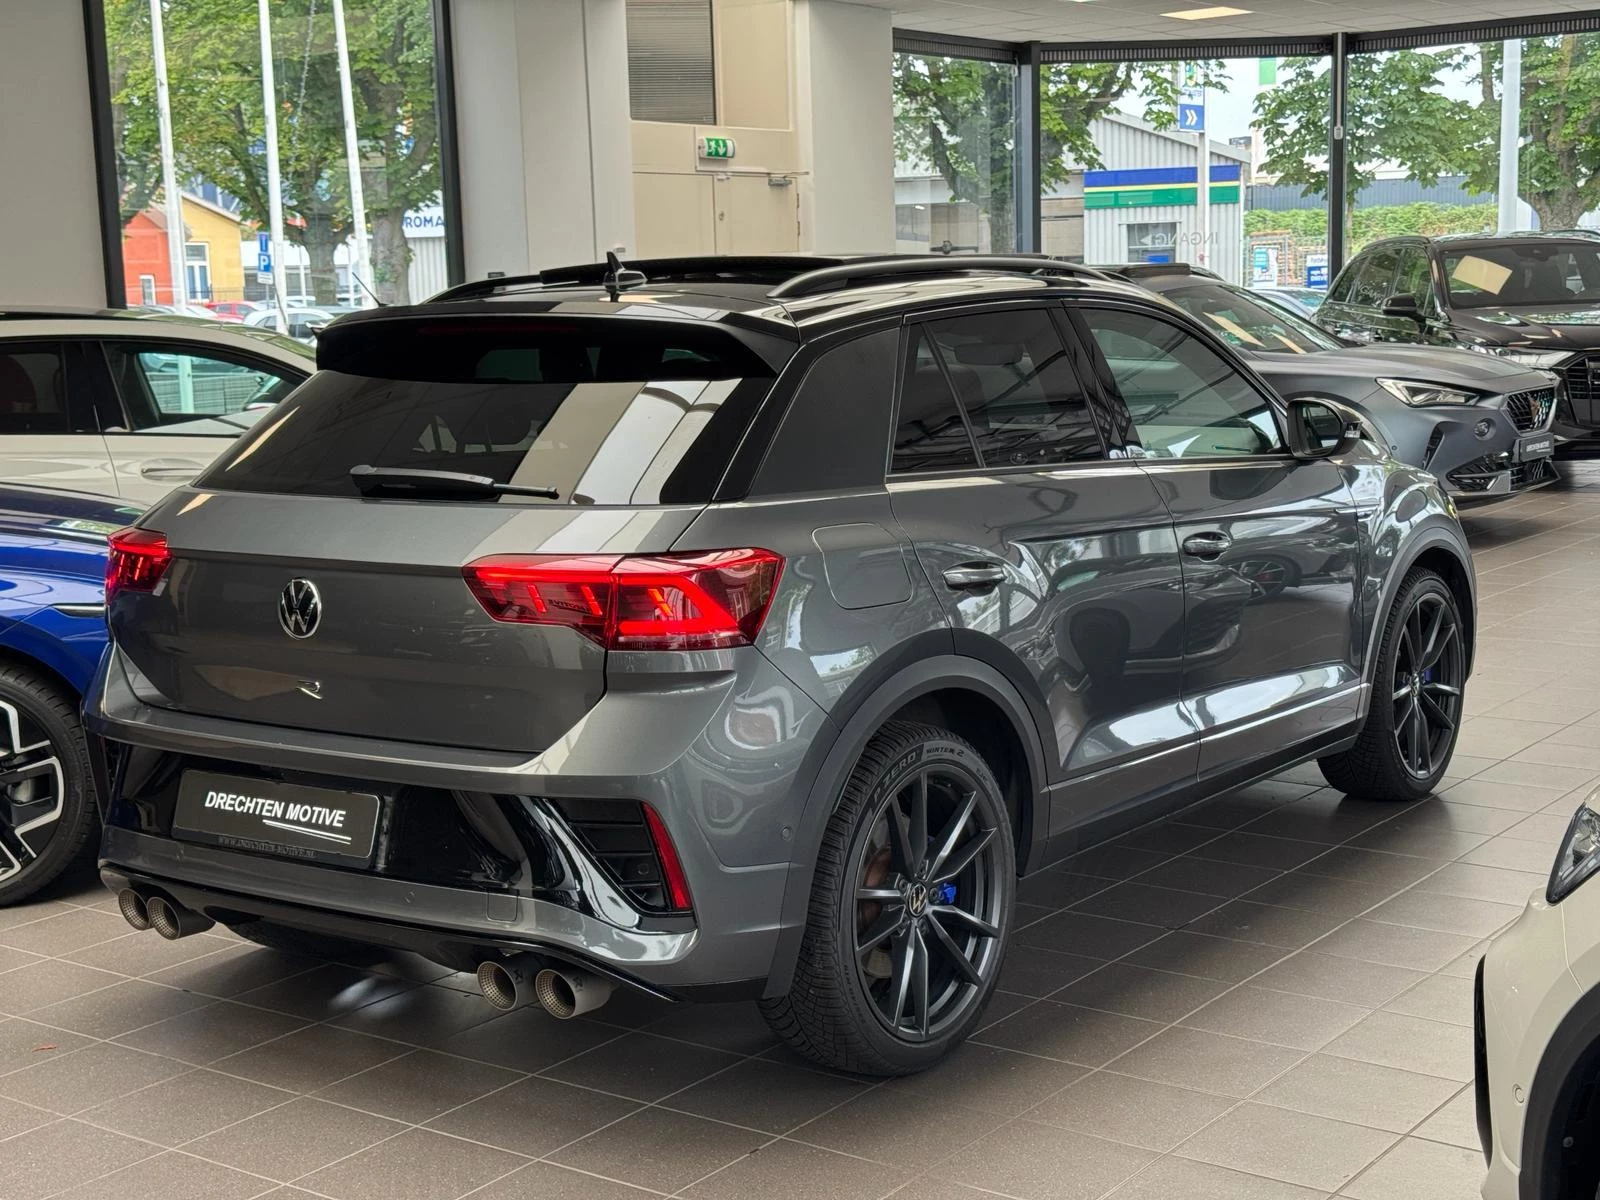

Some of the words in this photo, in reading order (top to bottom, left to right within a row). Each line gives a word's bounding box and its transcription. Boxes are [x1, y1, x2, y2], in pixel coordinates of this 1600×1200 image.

[401, 215, 446, 228] ROMA
[260, 255, 269, 271] P
[882, 751, 916, 789] ZERO
[926, 746, 955, 755] WINTER
[956, 749, 965, 758] 2
[204, 791, 285, 818] DRECHTEN
[286, 803, 346, 828] MOTIVE
